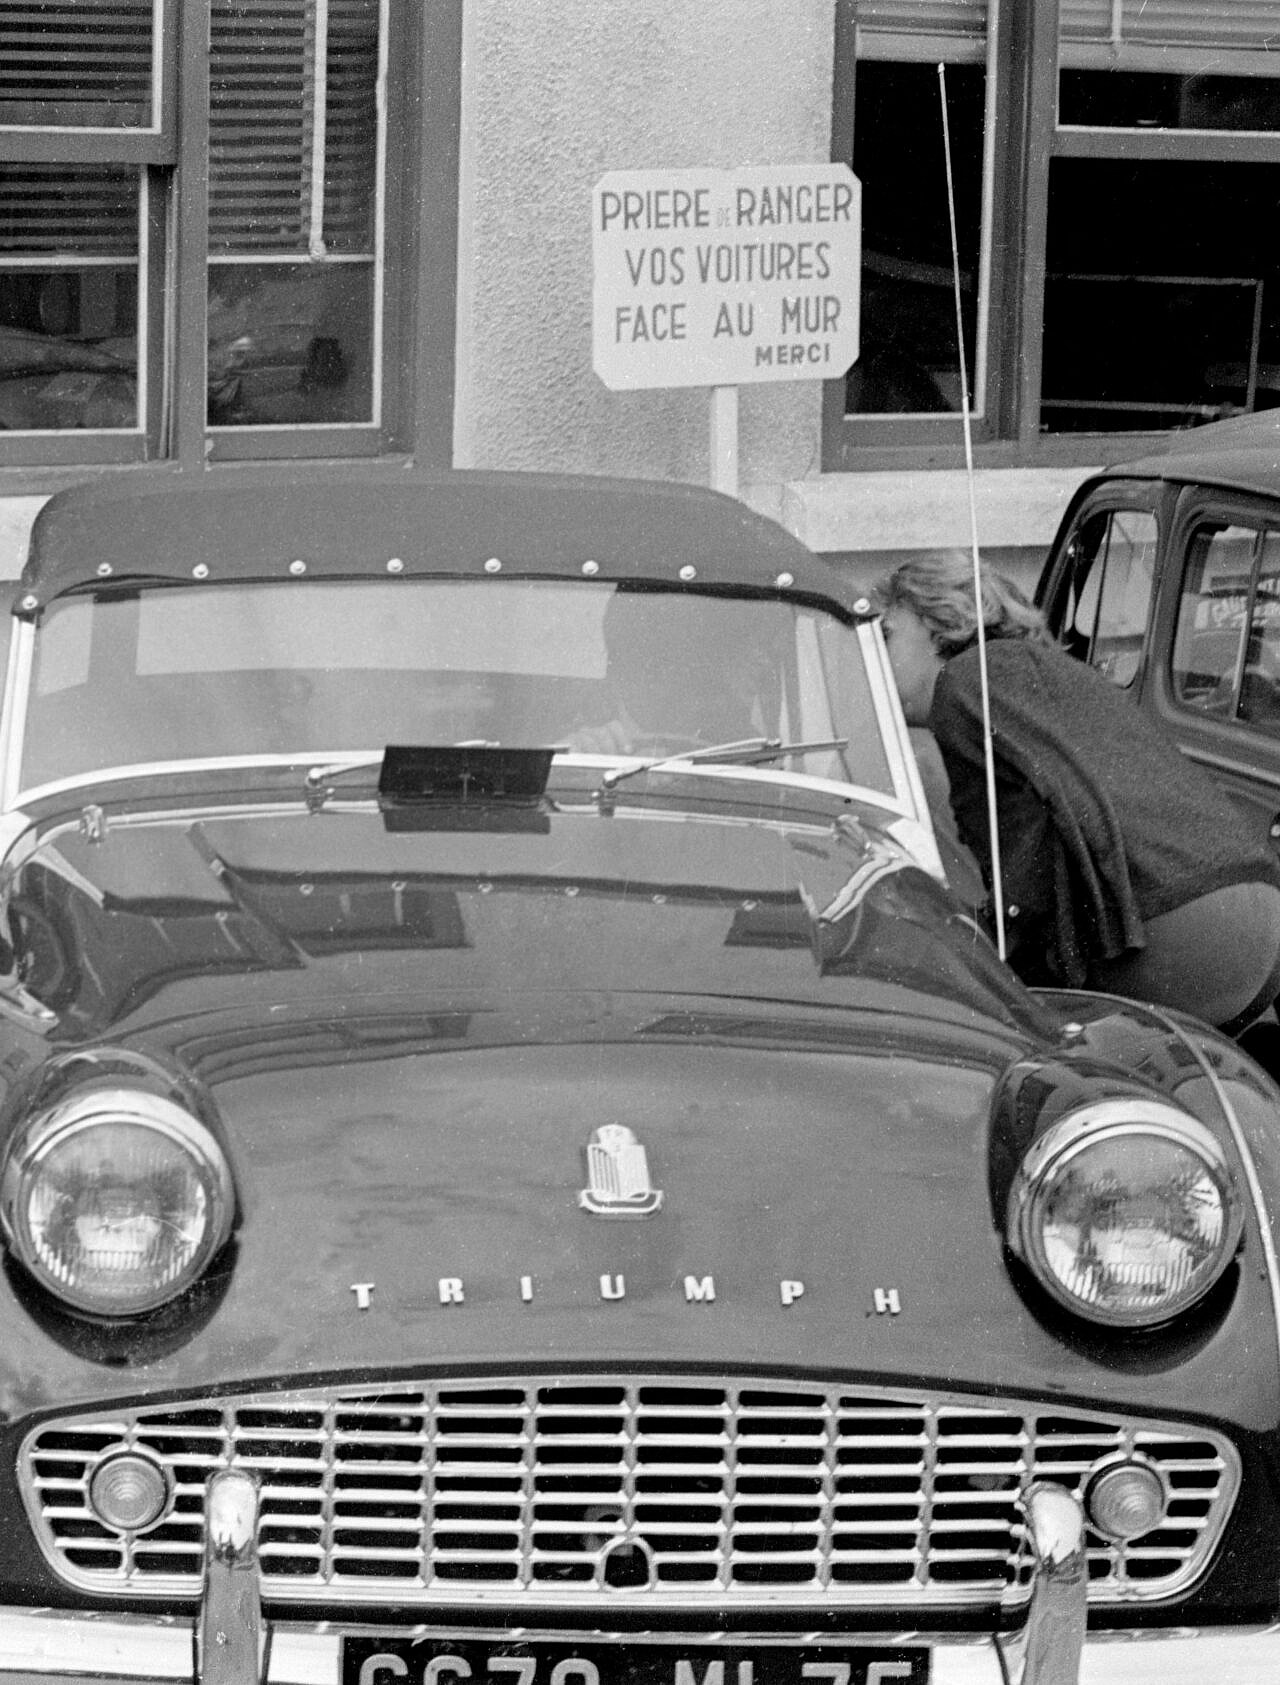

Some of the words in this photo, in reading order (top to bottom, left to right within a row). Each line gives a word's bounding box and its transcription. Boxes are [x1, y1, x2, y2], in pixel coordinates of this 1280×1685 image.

[600, 189, 710, 231] PRIERE
[736, 183, 853, 227] RANGER
[625, 246, 685, 287] VOS
[696, 241, 831, 283] VOITURES
[615, 303, 687, 343] FACE
[712, 302, 754, 338] AU
[781, 295, 841, 334] MUR
[755, 342, 831, 366] MERCI
[350, 1273, 902, 1314] TRIUMPH
